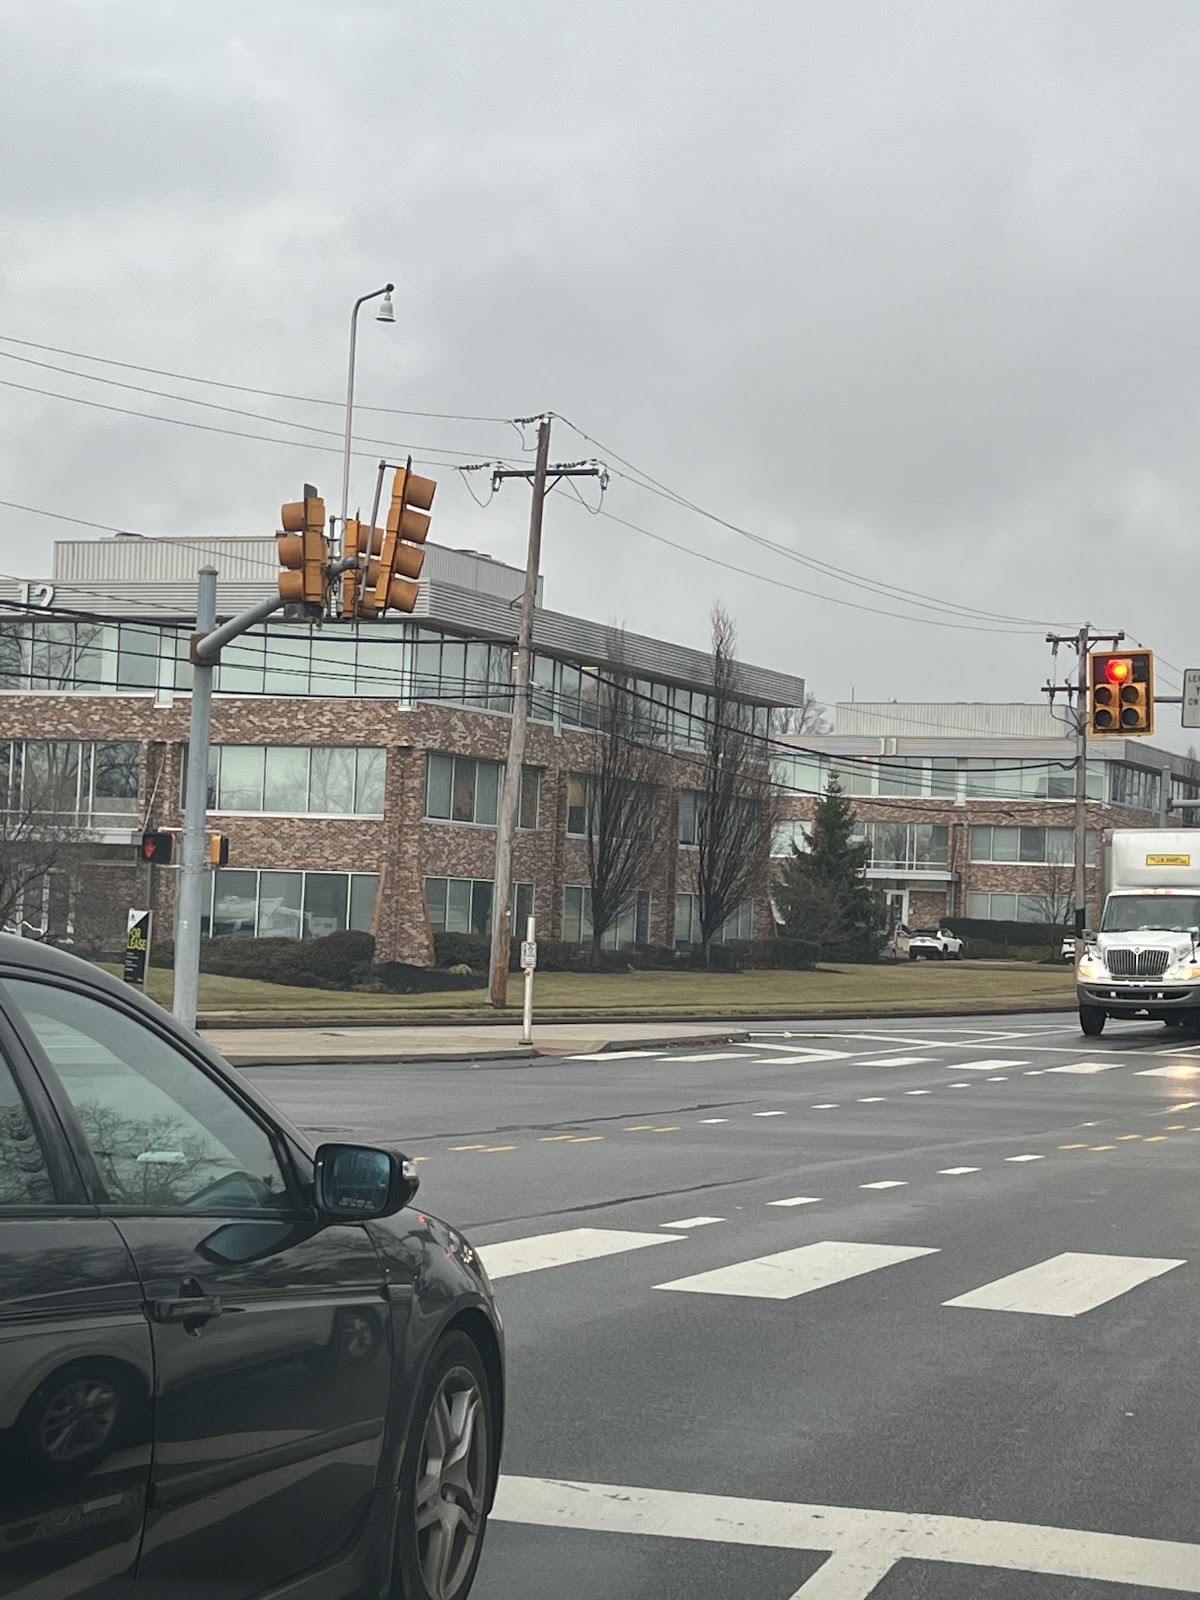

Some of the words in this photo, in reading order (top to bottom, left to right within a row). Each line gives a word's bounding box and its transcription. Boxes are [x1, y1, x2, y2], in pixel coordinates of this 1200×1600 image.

[17, 582, 55, 614] 12
[128, 927, 141, 939] FOR
[127, 937, 147, 951] LEASE
